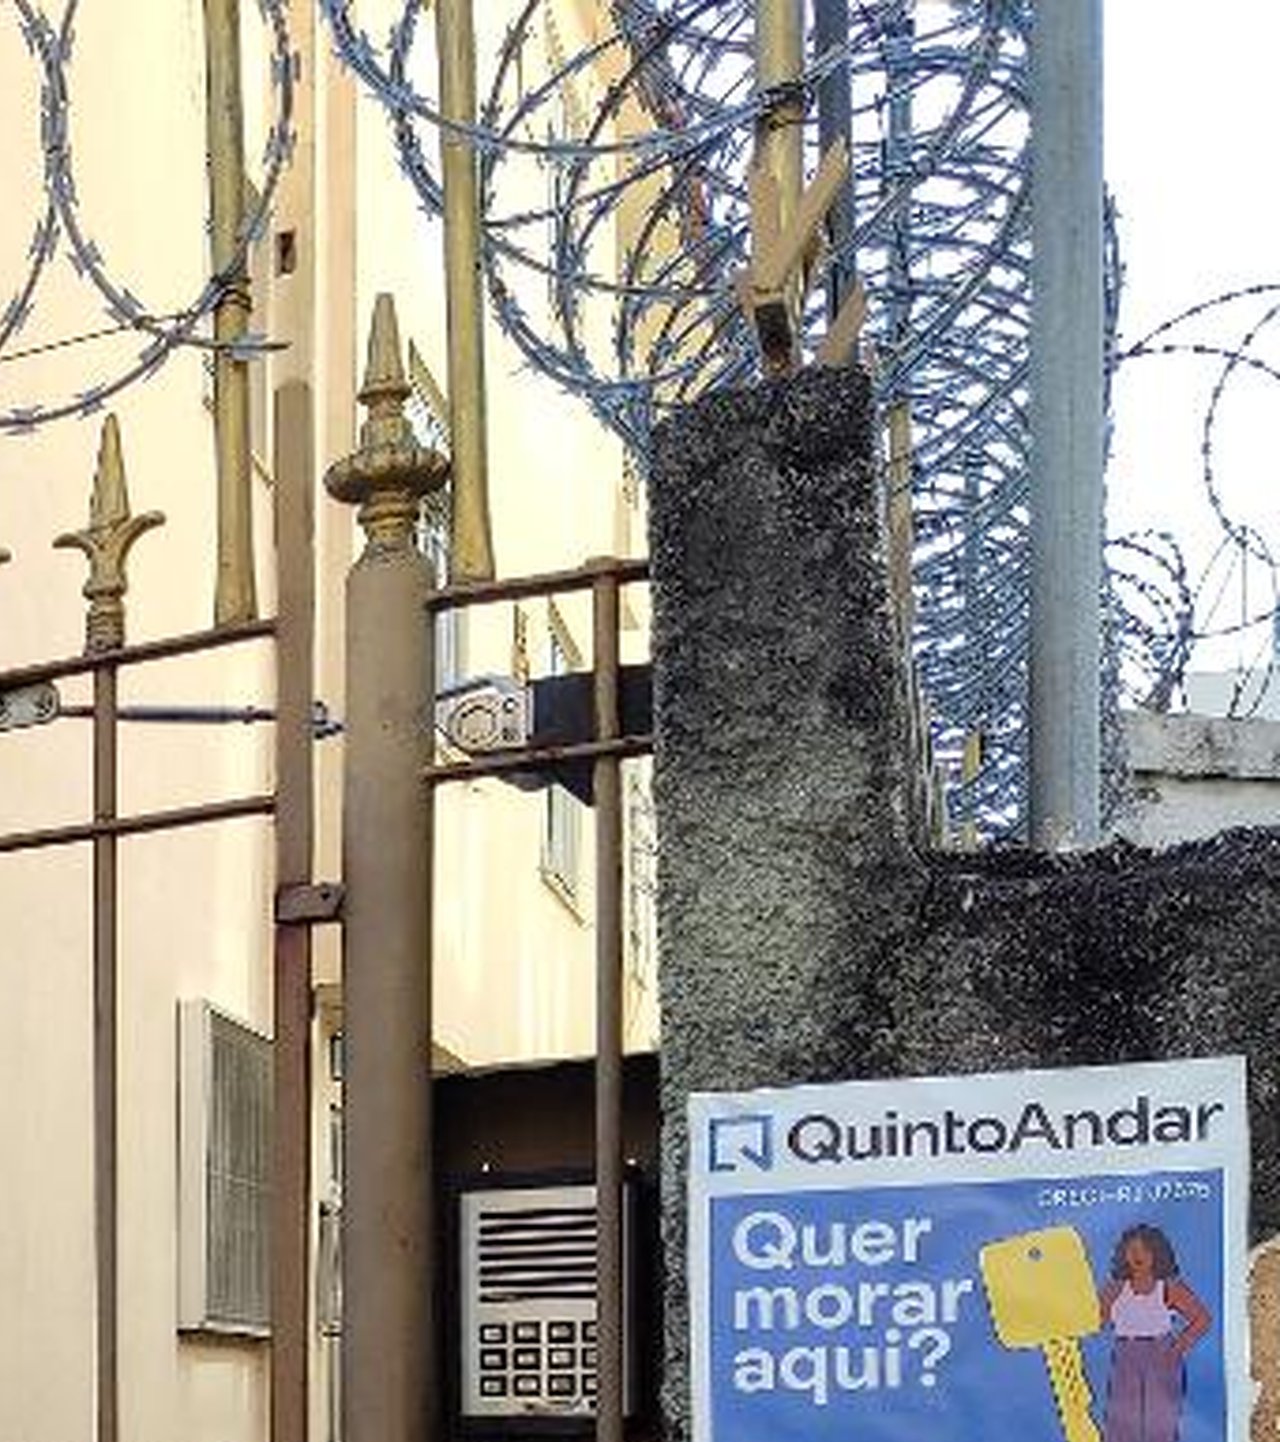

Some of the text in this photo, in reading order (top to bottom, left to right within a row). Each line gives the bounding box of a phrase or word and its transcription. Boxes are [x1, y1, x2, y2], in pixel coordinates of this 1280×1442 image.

[786, 1096, 1225, 1165] QuintoAndar
[732, 1211, 933, 1270] Quer
[734, 1278, 974, 1330] morar
[733, 1327, 952, 1405] aqui?
